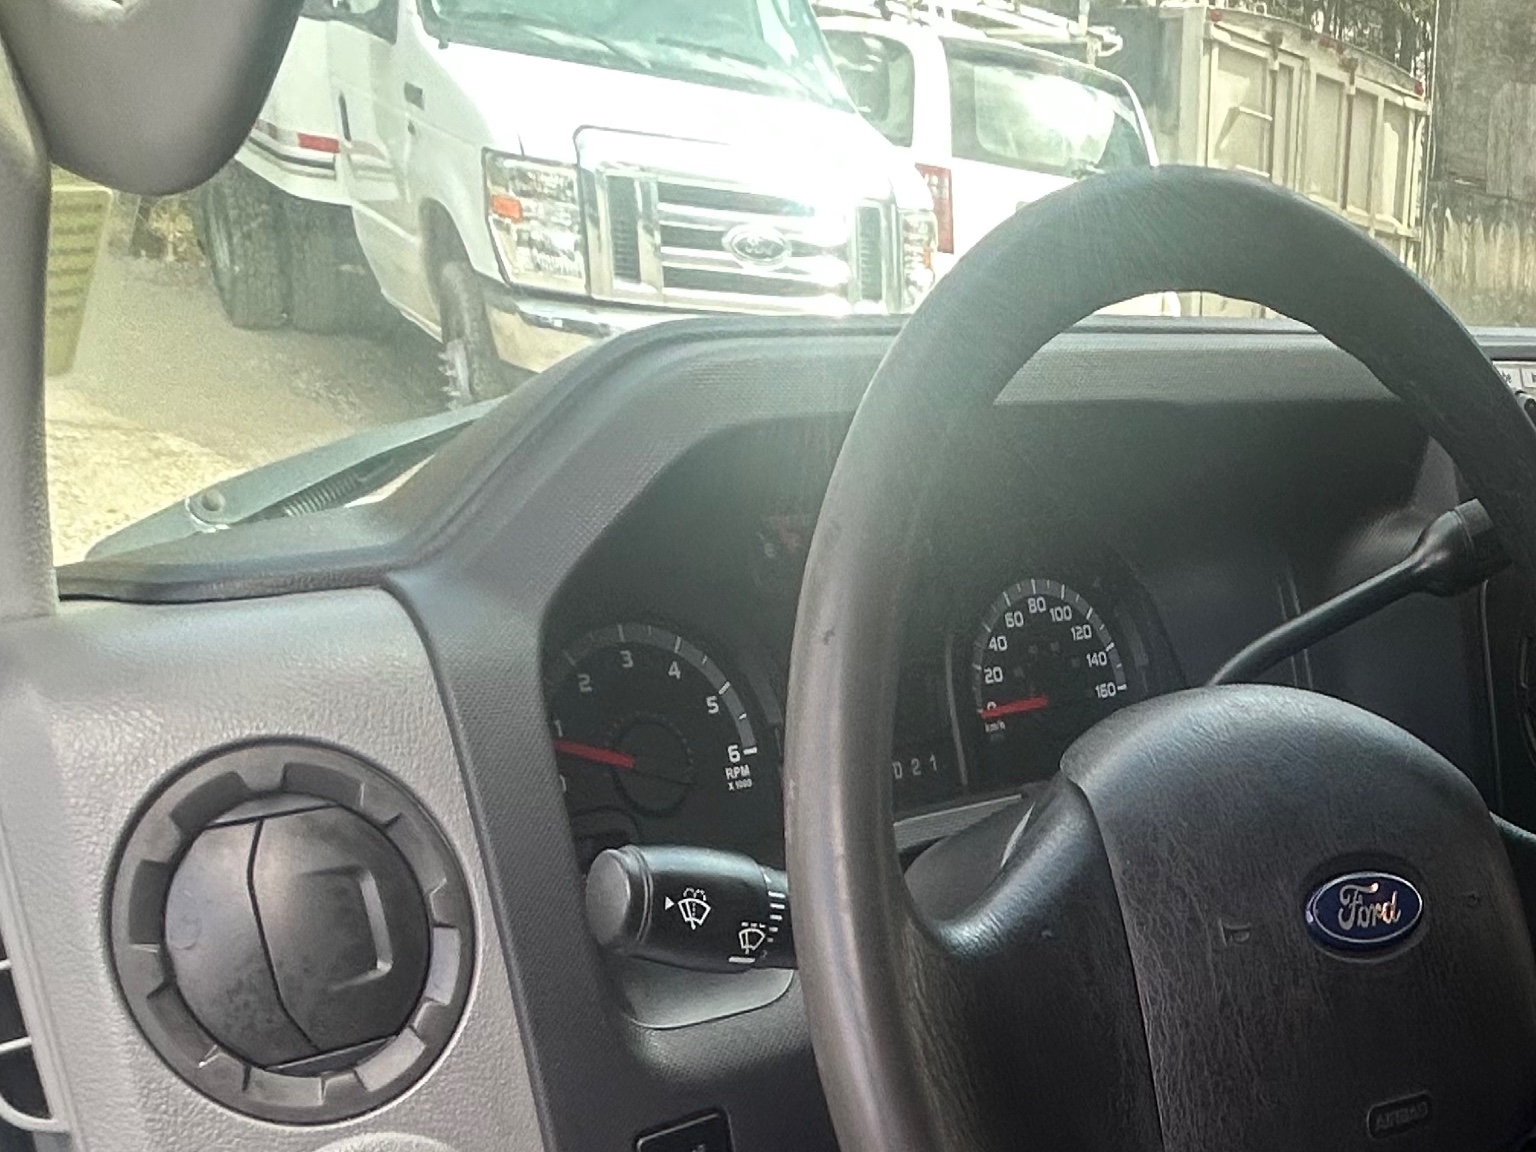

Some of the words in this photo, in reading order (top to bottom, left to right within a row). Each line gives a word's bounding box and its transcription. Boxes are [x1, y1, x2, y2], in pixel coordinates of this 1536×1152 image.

[1027, 596, 1047, 614] 80
[1049, 605, 1073, 622] 100
[1004, 611, 1024, 629] 60
[1070, 624, 1092, 641] 120
[988, 635, 1008, 652] 40
[619, 650, 634, 668] 3
[1086, 651, 1107, 667] 140
[668, 661, 681, 680] 4
[984, 667, 1003, 684] 20
[577, 673, 593, 693] 2
[1095, 684, 1117, 699] 160
[706, 696, 719, 714] 5
[727, 744, 741, 763] 6
[725, 764, 750, 780] RPM
[1338, 882, 1402, 931] Ford
